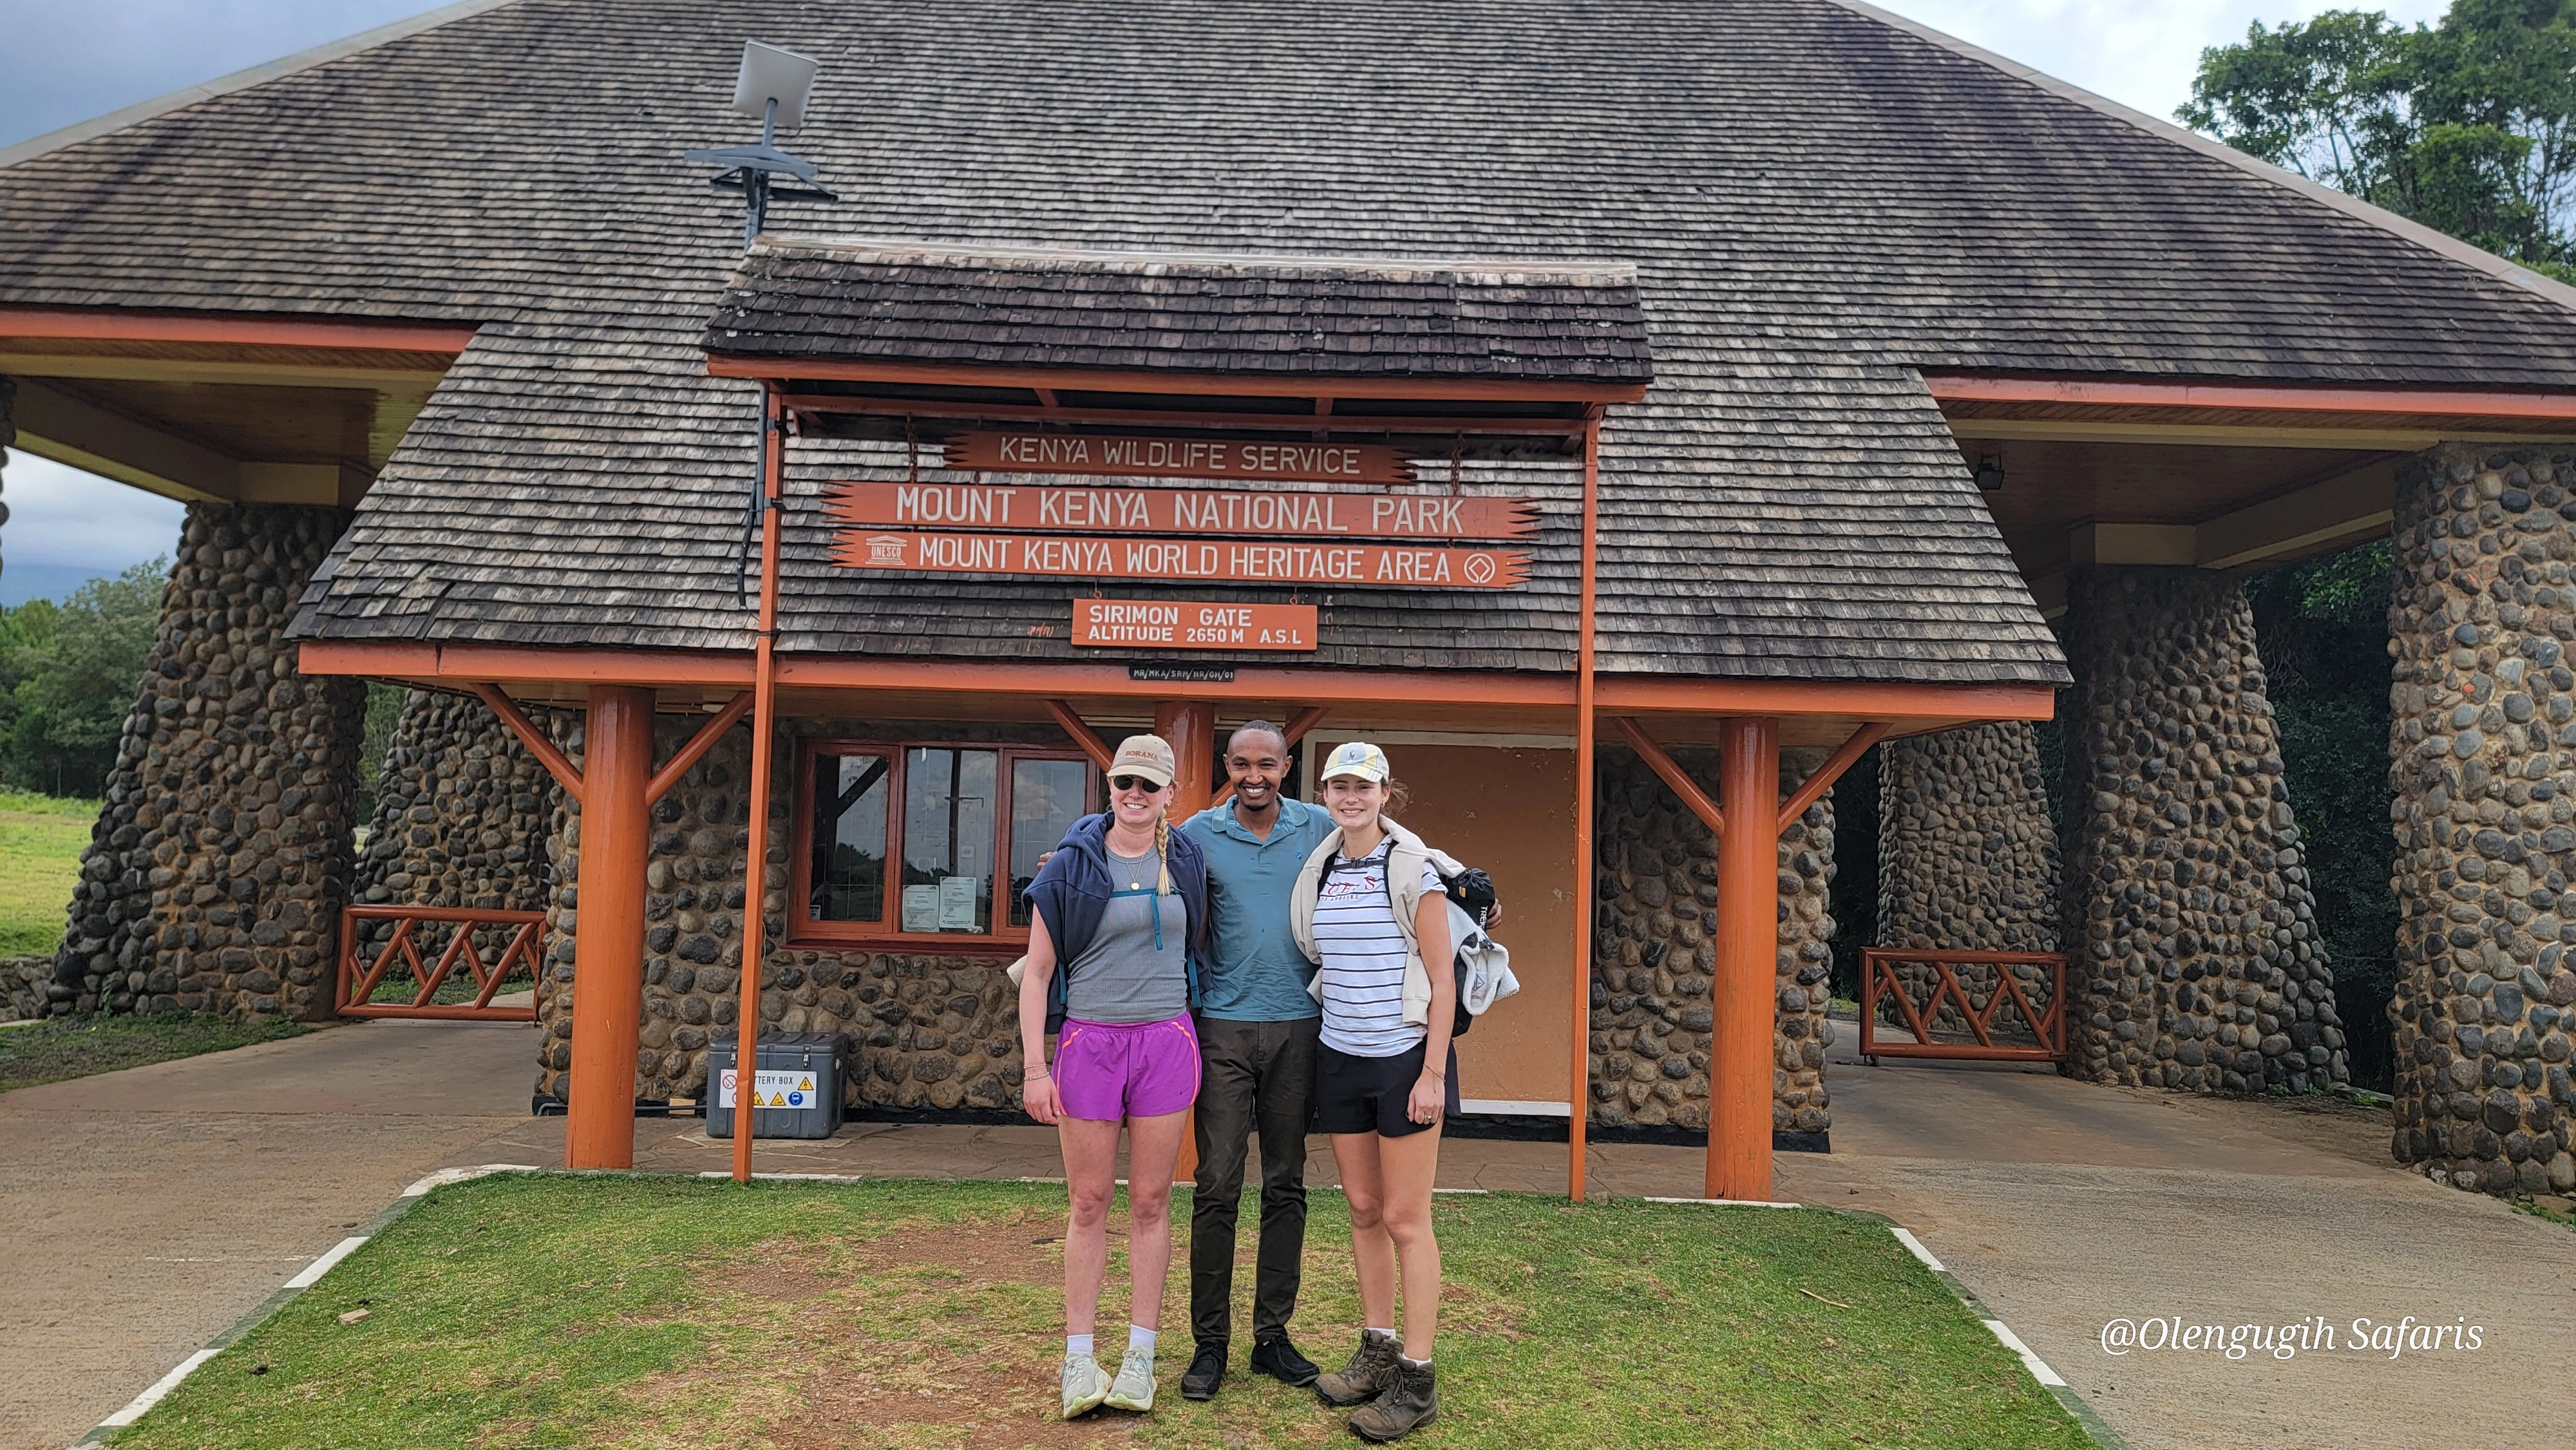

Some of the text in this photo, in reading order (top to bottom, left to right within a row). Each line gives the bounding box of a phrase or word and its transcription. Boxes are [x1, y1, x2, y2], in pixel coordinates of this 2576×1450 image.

[999, 437, 1361, 475] KENYA WILDLIFE SERVICE
[896, 485, 1464, 534] MOUNT KENYA NATIONAL PARK
[871, 546, 901, 558] UNESCO
[919, 536, 1451, 582] MOUNT KENYA WORLD HERITAGE AREA
[1090, 605, 1253, 627] SIRIMON GATE
[1088, 625, 1173, 642] ALTITUDE
[1259, 629, 1302, 645] A.S.L
[1125, 751, 1159, 762] BORANA
[755, 1076, 793, 1085] TERY BOX
